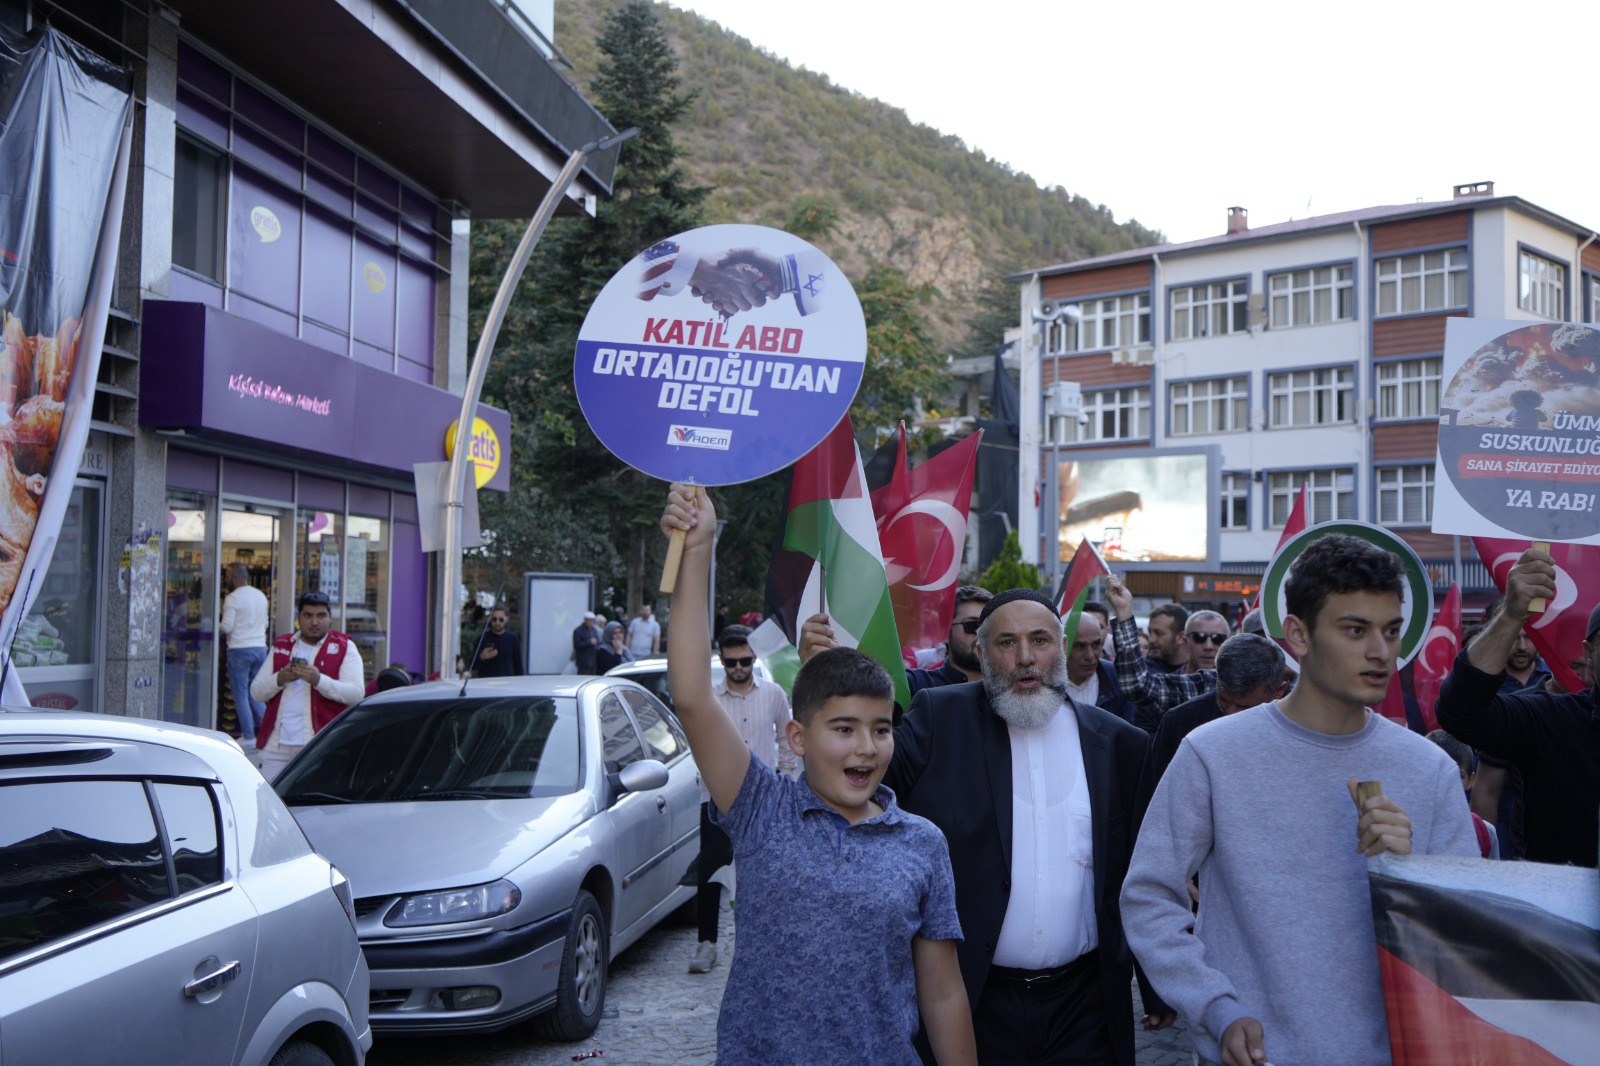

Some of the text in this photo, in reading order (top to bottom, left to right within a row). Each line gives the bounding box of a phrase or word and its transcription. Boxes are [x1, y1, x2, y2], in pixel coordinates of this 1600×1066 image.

[643, 317, 803, 354] KATİL ABD
[593, 348, 841, 394] ORTADOĞU'DAN
[657, 382, 759, 416] DEFOL
[1466, 459, 1502, 471] SANA
[1505, 458, 1562, 475] ŞİKAYET
[1506, 489, 1595, 512] YA RAB!
